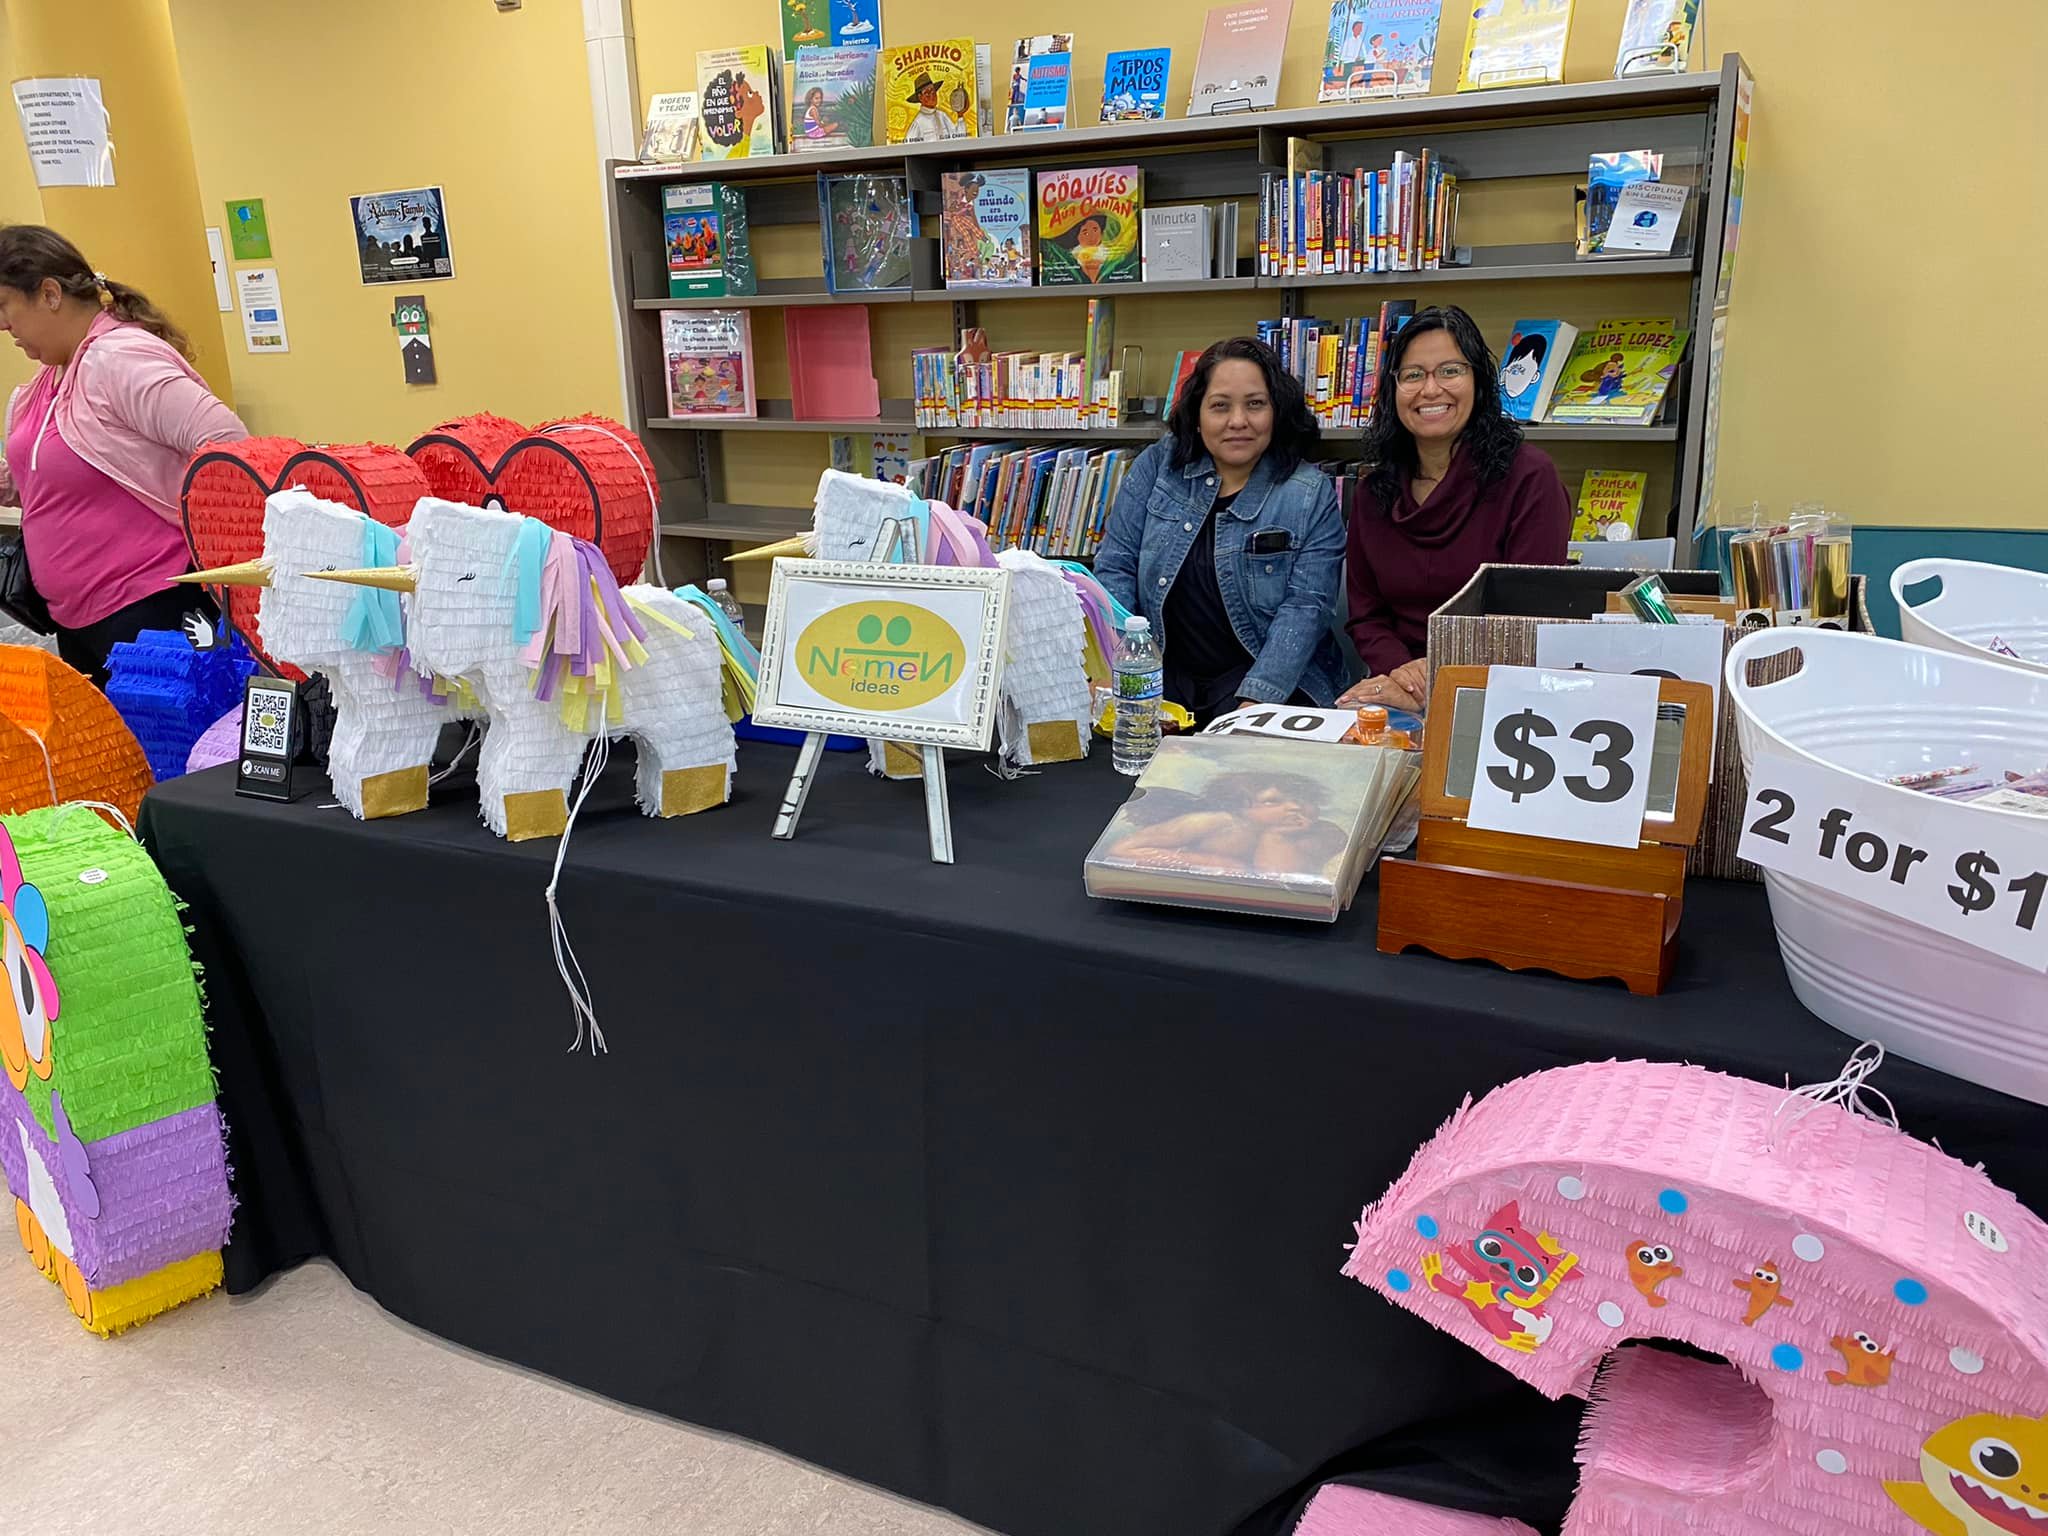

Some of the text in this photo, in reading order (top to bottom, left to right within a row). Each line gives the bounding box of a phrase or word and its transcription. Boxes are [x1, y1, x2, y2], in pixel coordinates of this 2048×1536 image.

[842, 37, 870, 46] Invierno
[800, 54, 820, 62] Alicia
[834, 51, 869, 60] Hurricane
[894, 44, 962, 71] SHARUKO
[799, 71, 818, 79] Alicia
[933, 64, 950, 73] TELLO
[1032, 65, 1068, 79] AUTISMO
[718, 77, 726, 85] EL
[708, 118, 741, 137] VOLAR
[1056, 172, 1070, 182] LOS
[1042, 169, 1129, 208] COQUÍES
[1626, 182, 1684, 196] DISCIPLINA
[979, 194, 1016, 206] mundo
[396, 199, 426, 222] Family
[980, 213, 1020, 224] nuestro
[1151, 211, 1197, 226] Minutka
[1590, 332, 1677, 349] LUPE LOPEZ
[1590, 480, 1638, 490] PRIMERA
[1589, 500, 1629, 512] PUNK
[850, 678, 901, 696] ideas
[1208, 711, 1326, 734] $10
[1486, 707, 1635, 804] $3
[253, 764, 281, 777] SCAN ME
[1748, 788, 2048, 932] 2 for $1
